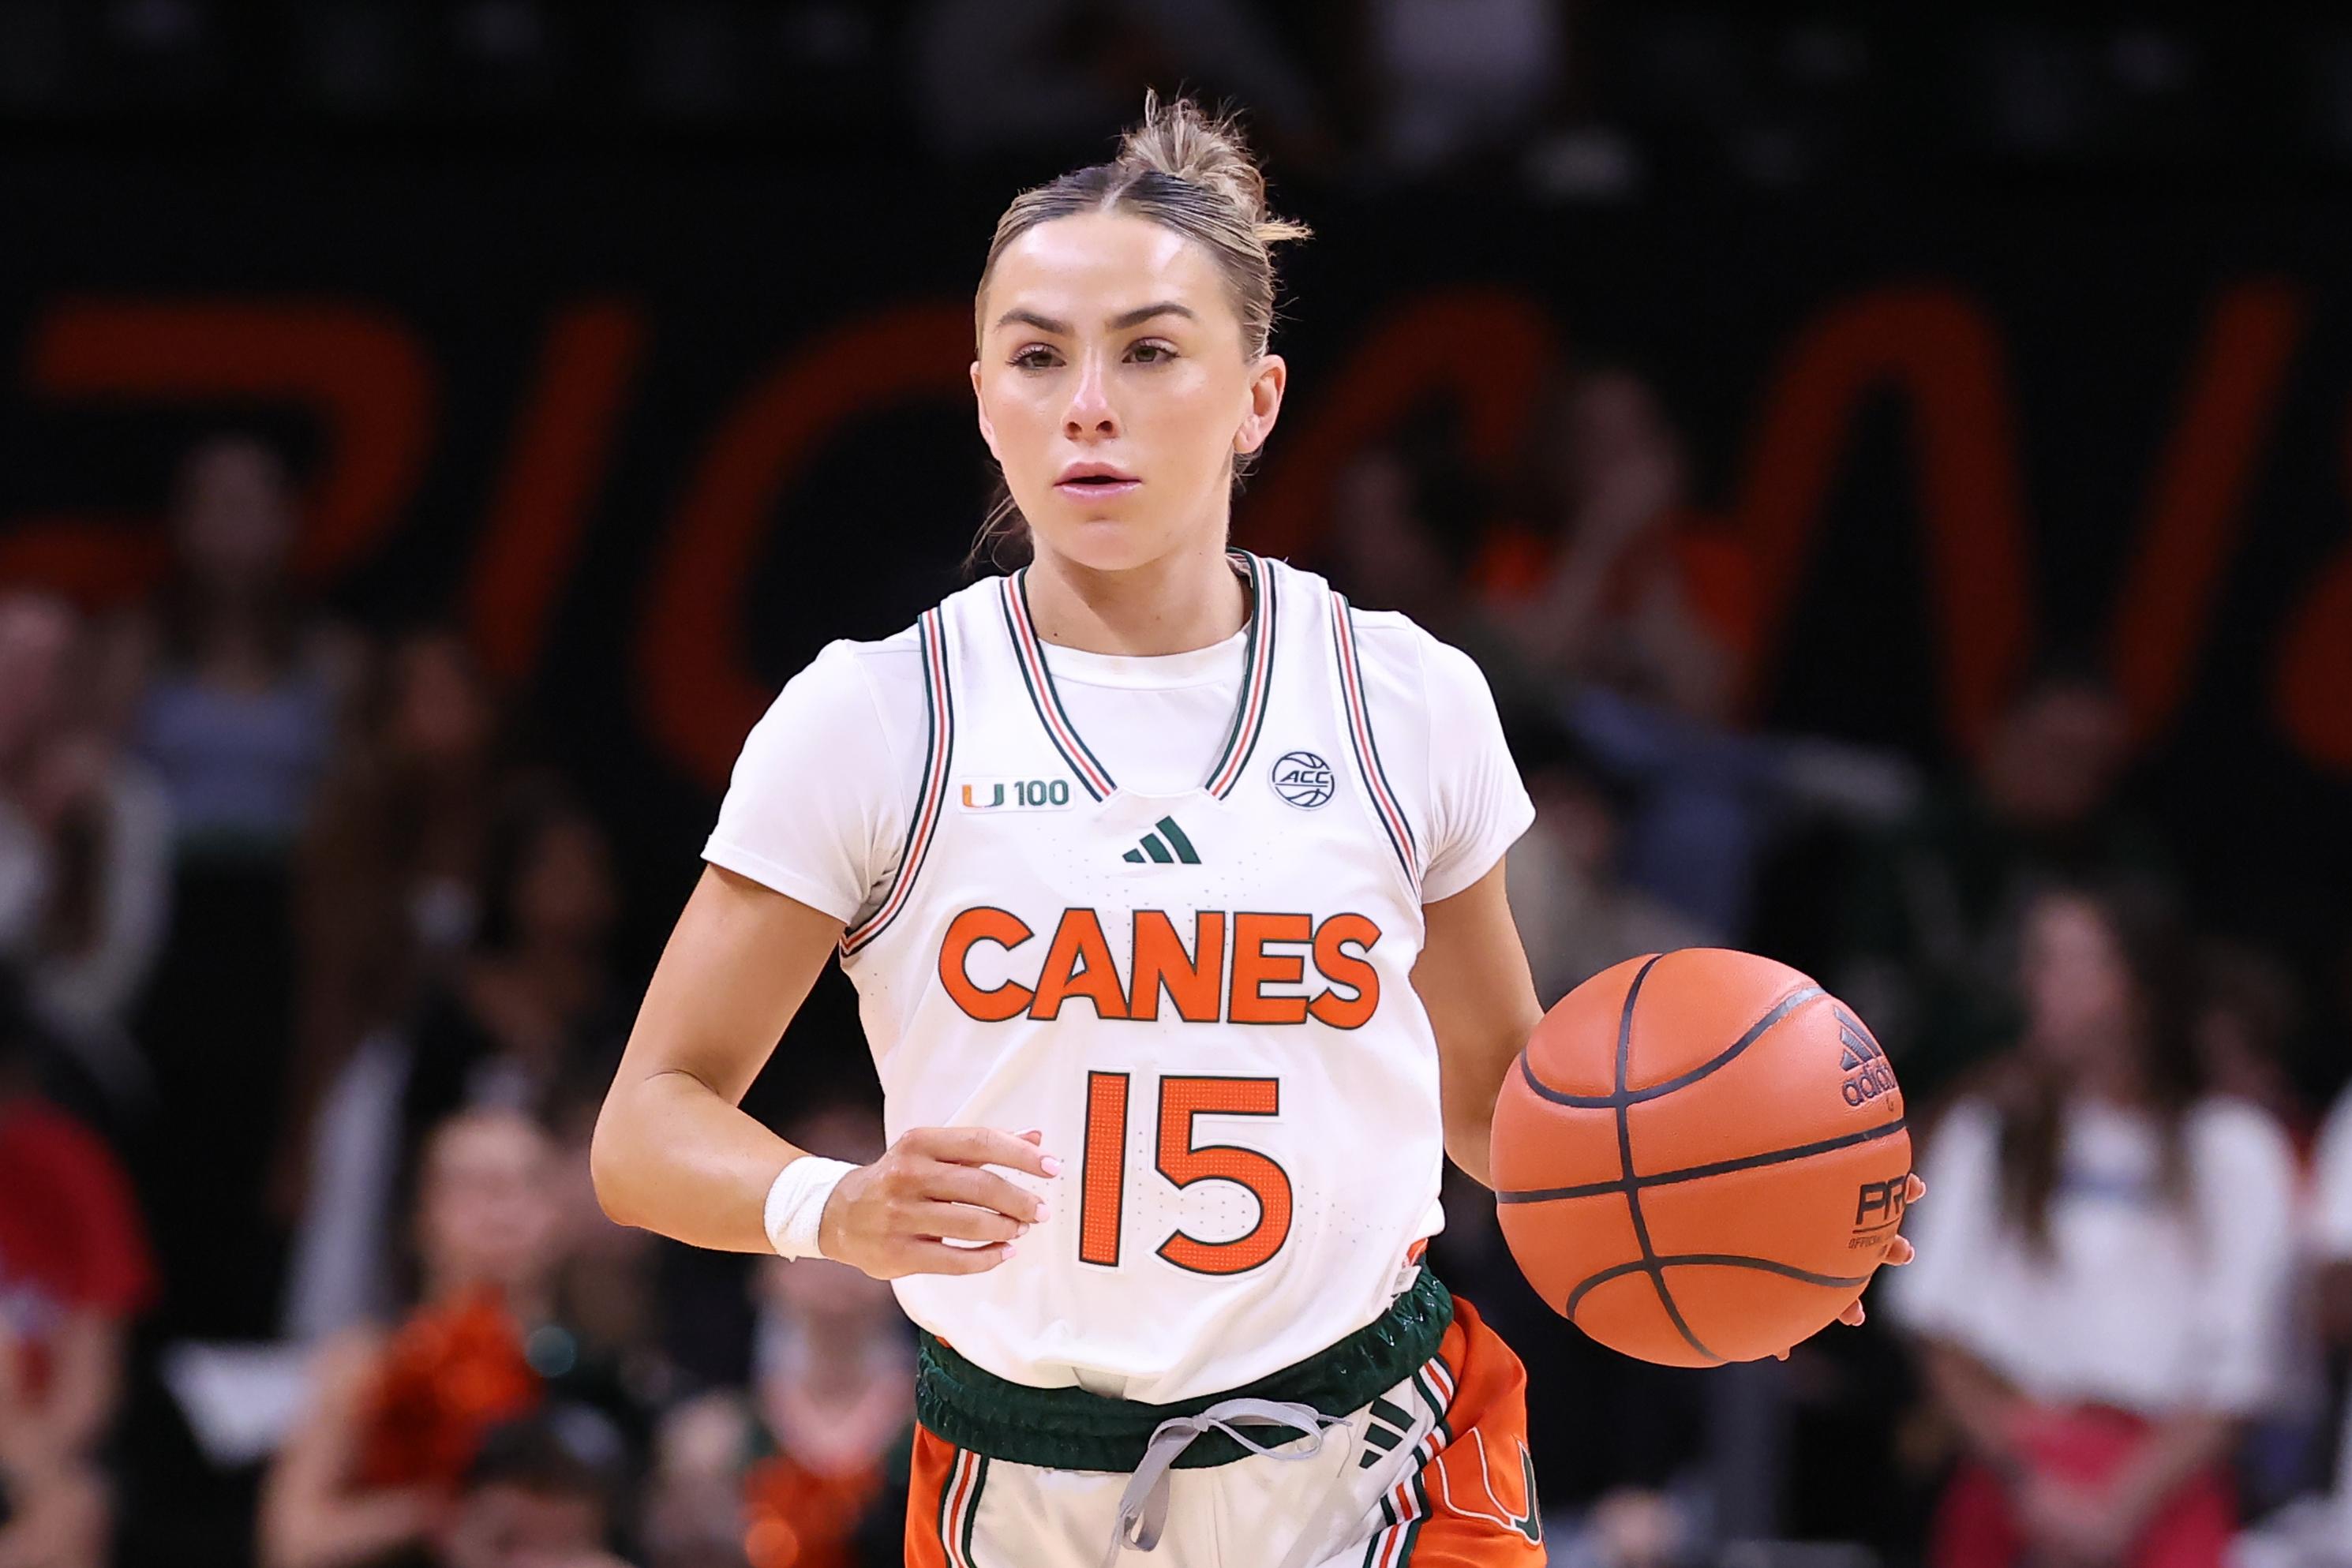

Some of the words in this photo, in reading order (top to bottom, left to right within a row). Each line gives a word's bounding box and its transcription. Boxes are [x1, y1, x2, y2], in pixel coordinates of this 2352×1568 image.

[961, 784, 1004, 808] U
[1014, 780, 1069, 806] 100
[1279, 770, 1331, 784] ACC
[938, 907, 1381, 1030] CANES
[1079, 1070, 1293, 1274] 15
[1856, 1175, 1906, 1225] PR
